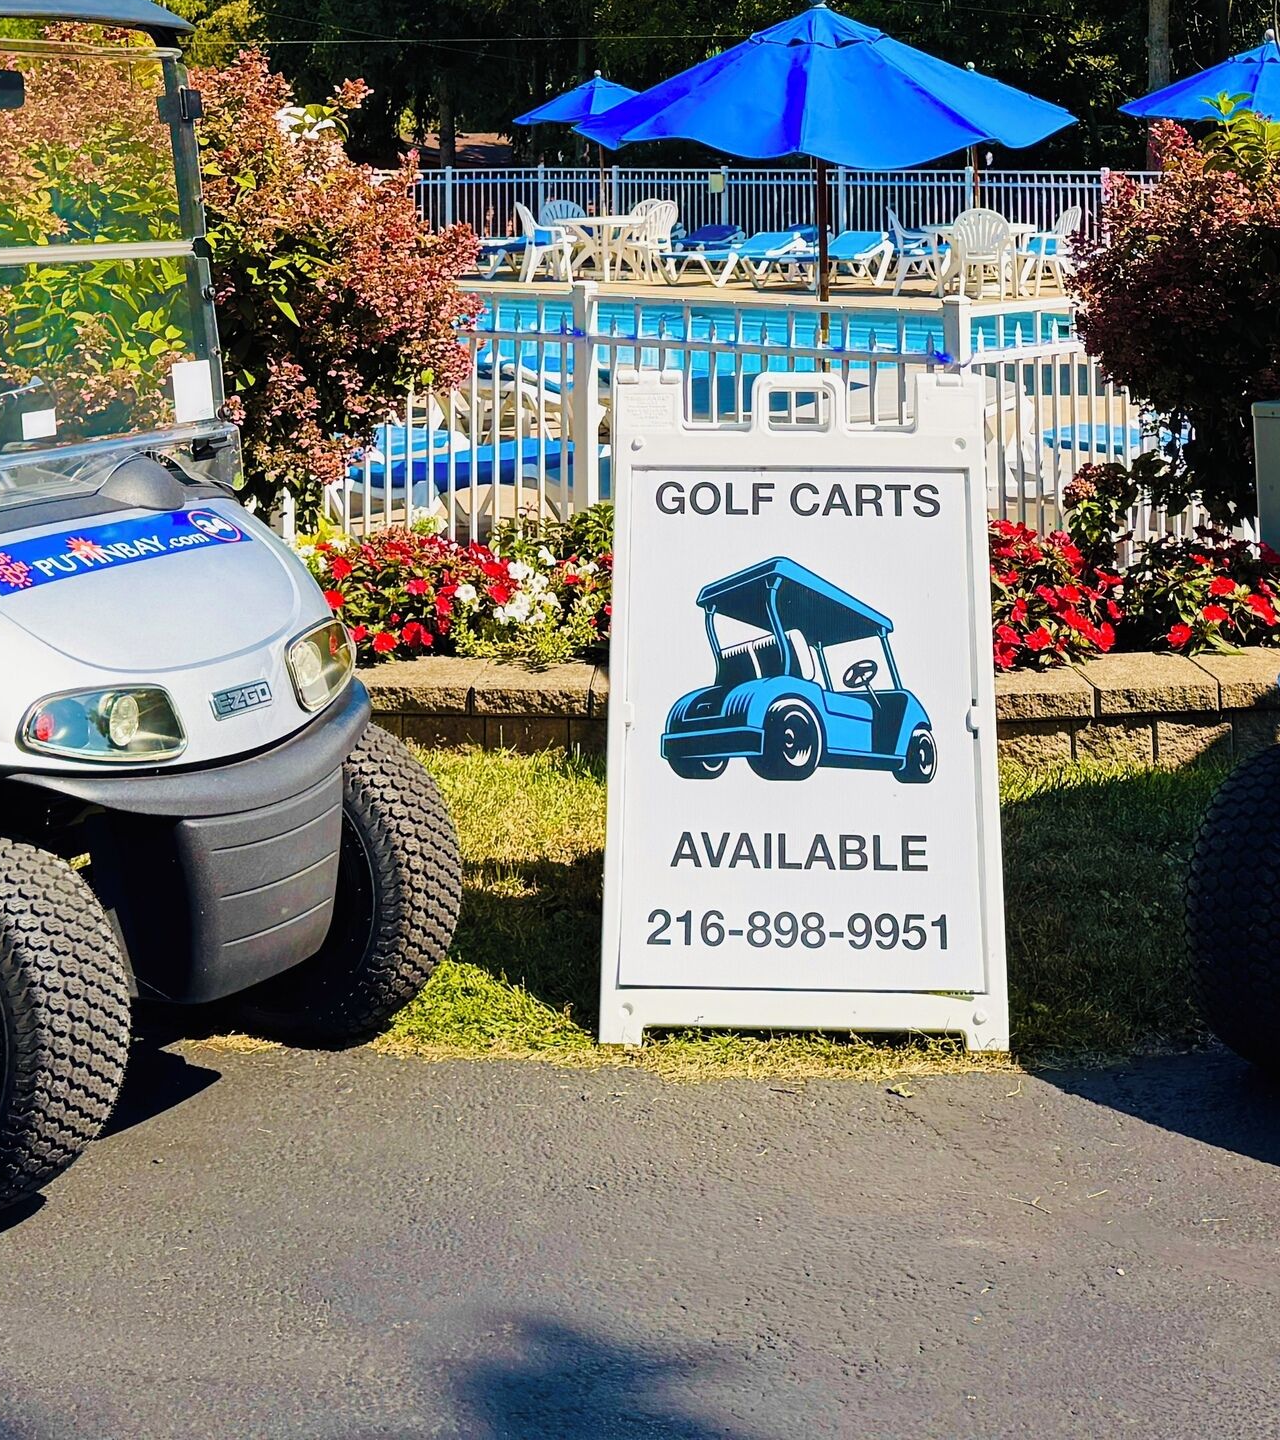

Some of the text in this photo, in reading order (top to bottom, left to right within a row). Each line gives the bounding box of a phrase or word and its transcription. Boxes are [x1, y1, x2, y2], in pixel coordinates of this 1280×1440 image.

[656, 481, 941, 518] GOLF CARTS
[196, 518, 233, 534] 34
[214, 682, 271, 713] EZGO
[670, 832, 929, 872] AVAILABLE
[646, 909, 948, 950] 216-898-9951
